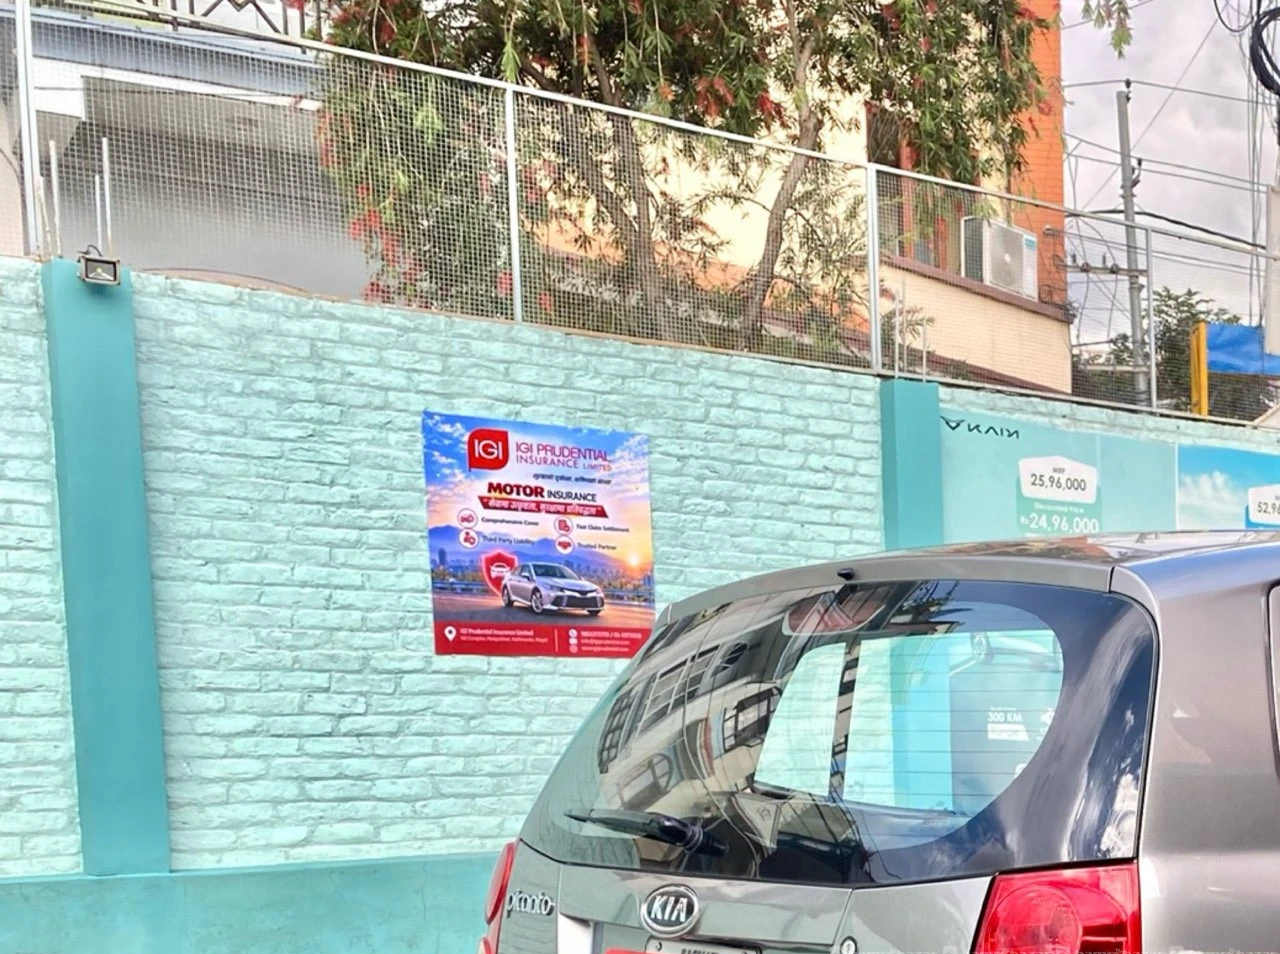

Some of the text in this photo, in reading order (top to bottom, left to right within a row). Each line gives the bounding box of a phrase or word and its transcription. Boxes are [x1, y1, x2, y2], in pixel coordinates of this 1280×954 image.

[473, 439, 503, 460] IGI
[516, 441, 611, 462] IGI PRUDENTIAL
[516, 454, 613, 472] INSURANCE LIMITED
[487, 482, 597, 502] MOTOR INSURANCE
[1030, 473, 1087, 492] 25,96,000
[1029, 512, 1099, 534] 24,96,000
[987, 711, 1023, 722] 300 KM
[650, 895, 688, 922] KIA
